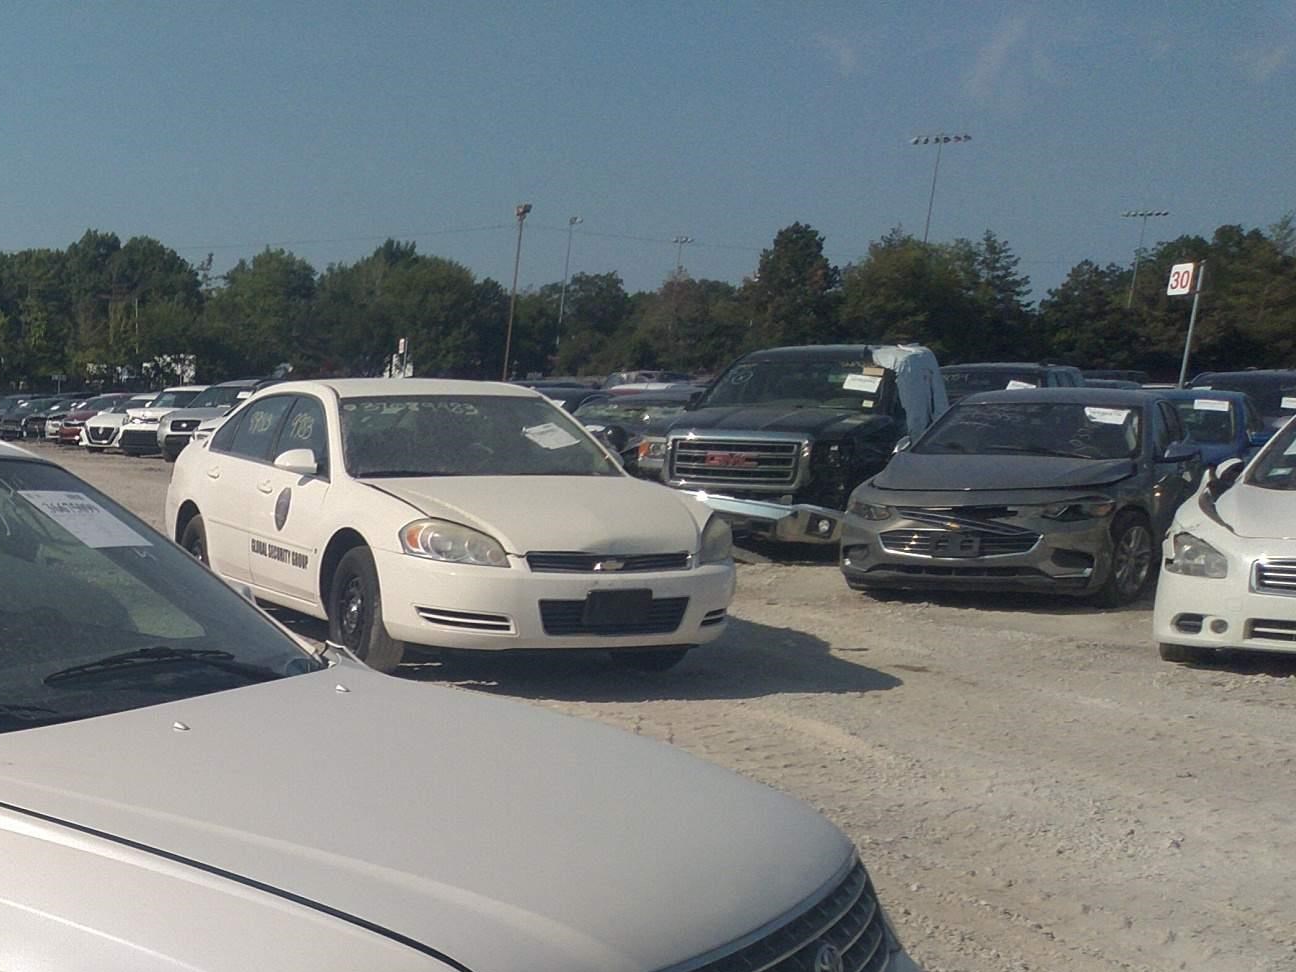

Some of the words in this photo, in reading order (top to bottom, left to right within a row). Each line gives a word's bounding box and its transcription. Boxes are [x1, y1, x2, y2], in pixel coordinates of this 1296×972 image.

[1170, 270, 1190, 289] 30
[705, 451, 759, 469] GMC
[251, 538, 268, 557] GLOBAL
[268, 543, 291, 565] SECURITY
[291, 551, 309, 570] GROUP
